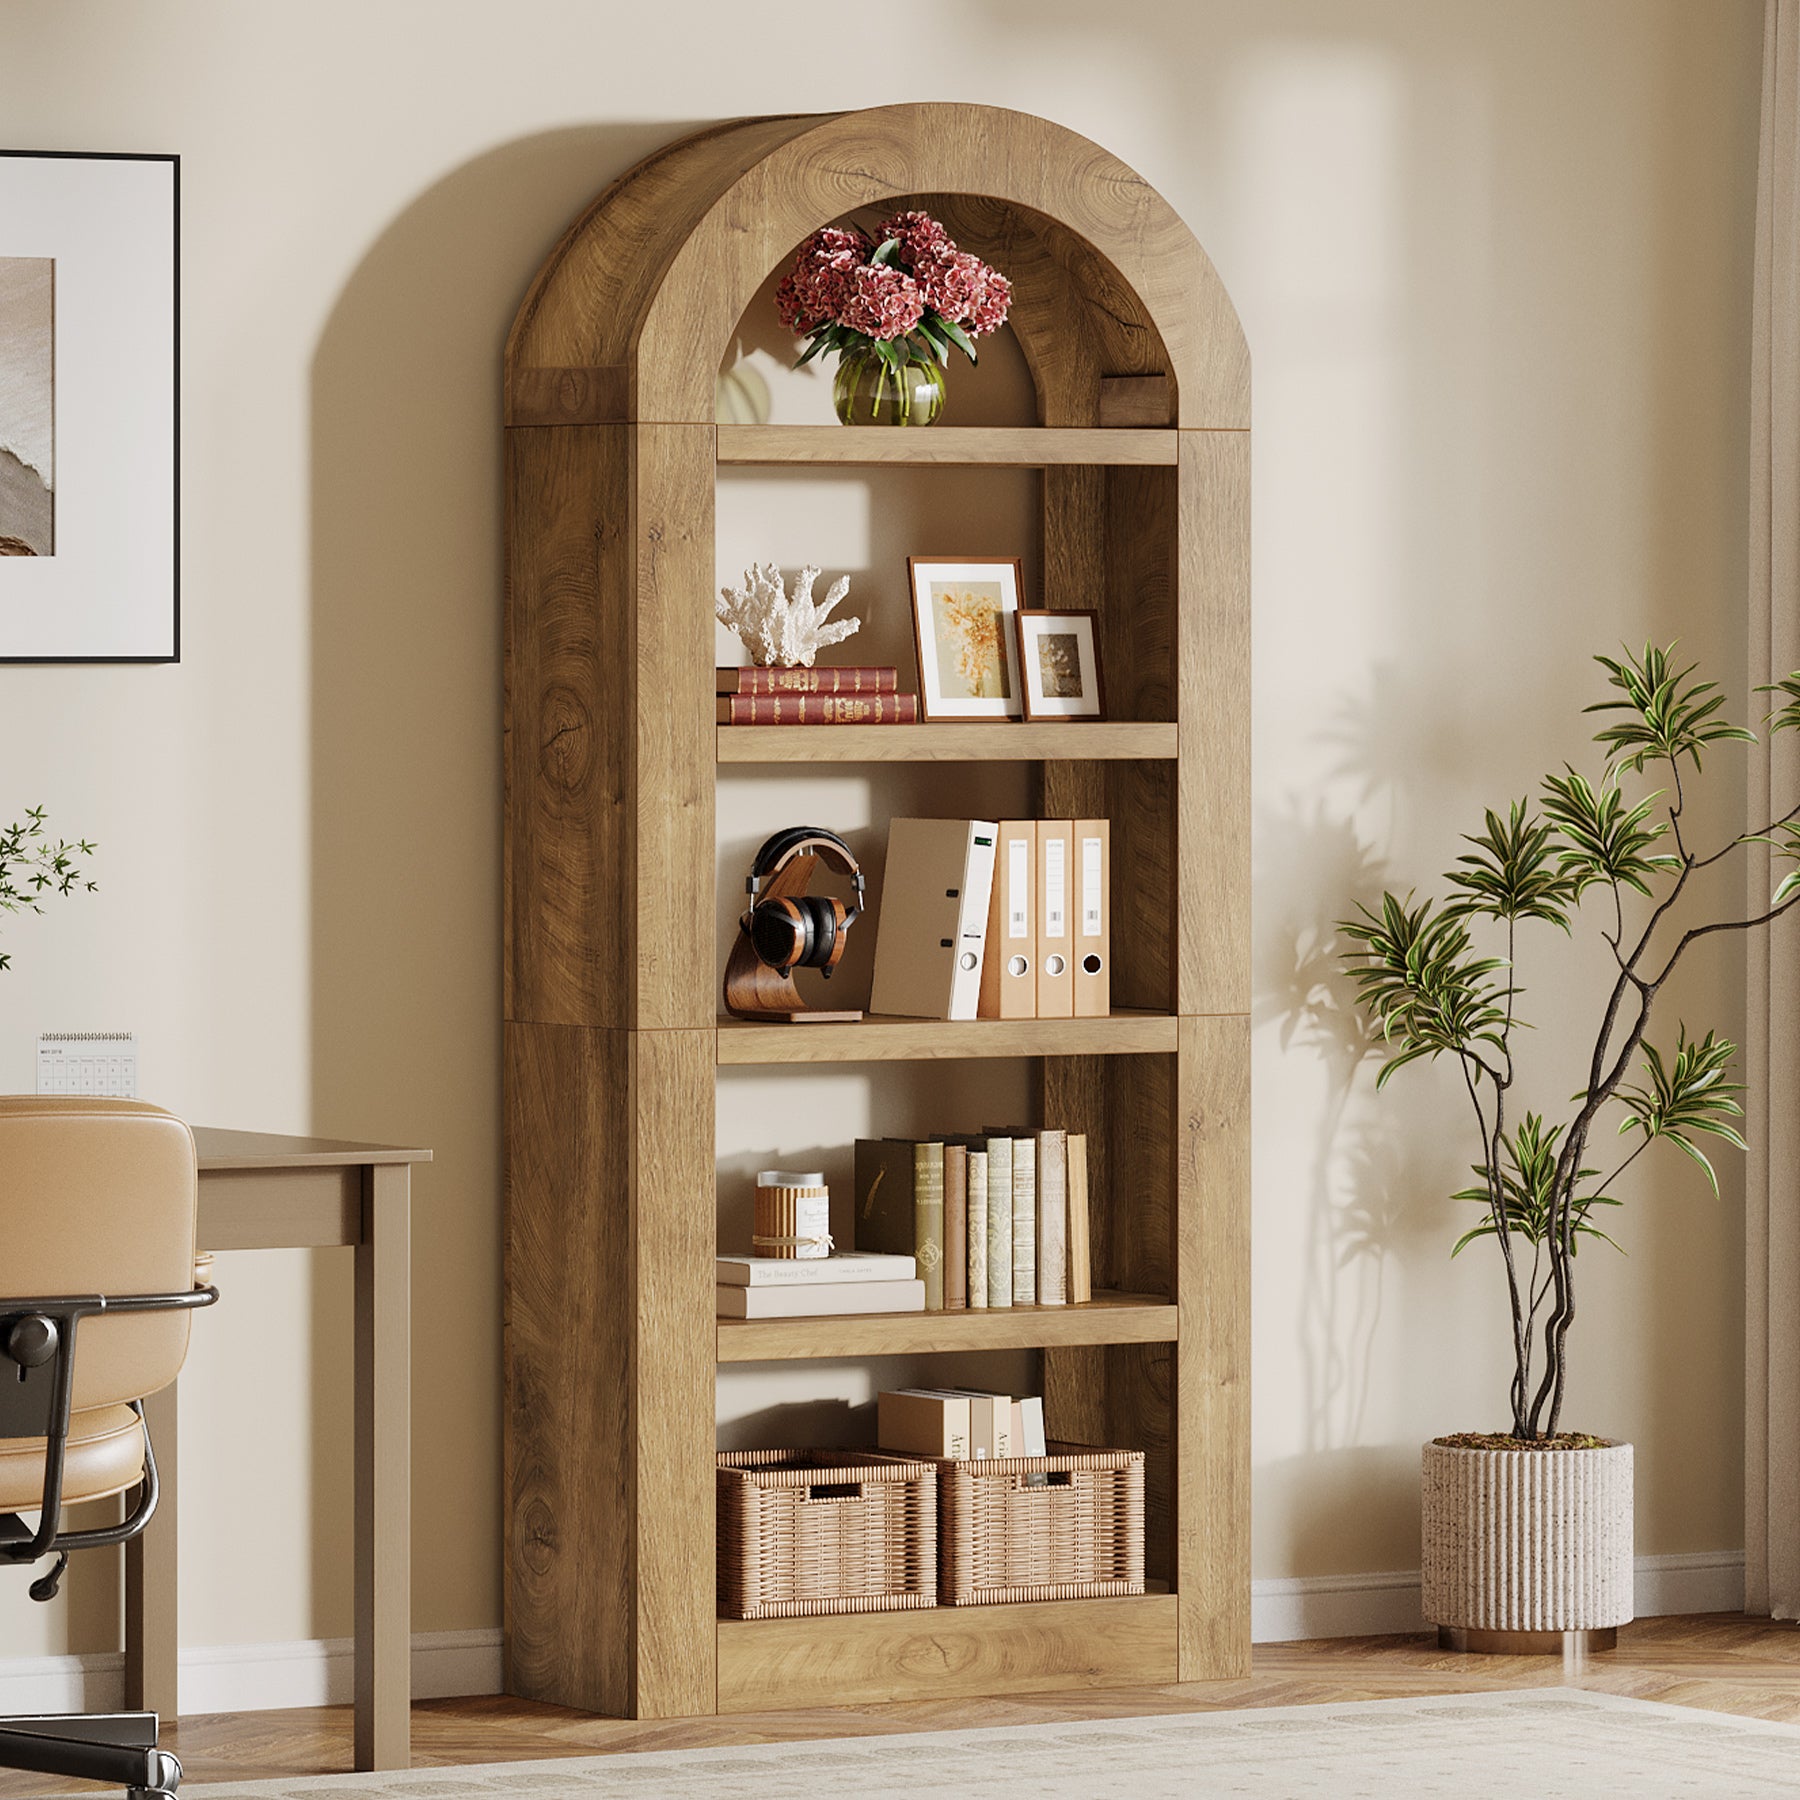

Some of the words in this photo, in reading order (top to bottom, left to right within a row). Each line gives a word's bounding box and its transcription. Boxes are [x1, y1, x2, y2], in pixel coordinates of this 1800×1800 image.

[757, 1270, 773, 1279] The
[773, 1269, 799, 1280] Beauty
[800, 1267, 819, 1278] Chef
